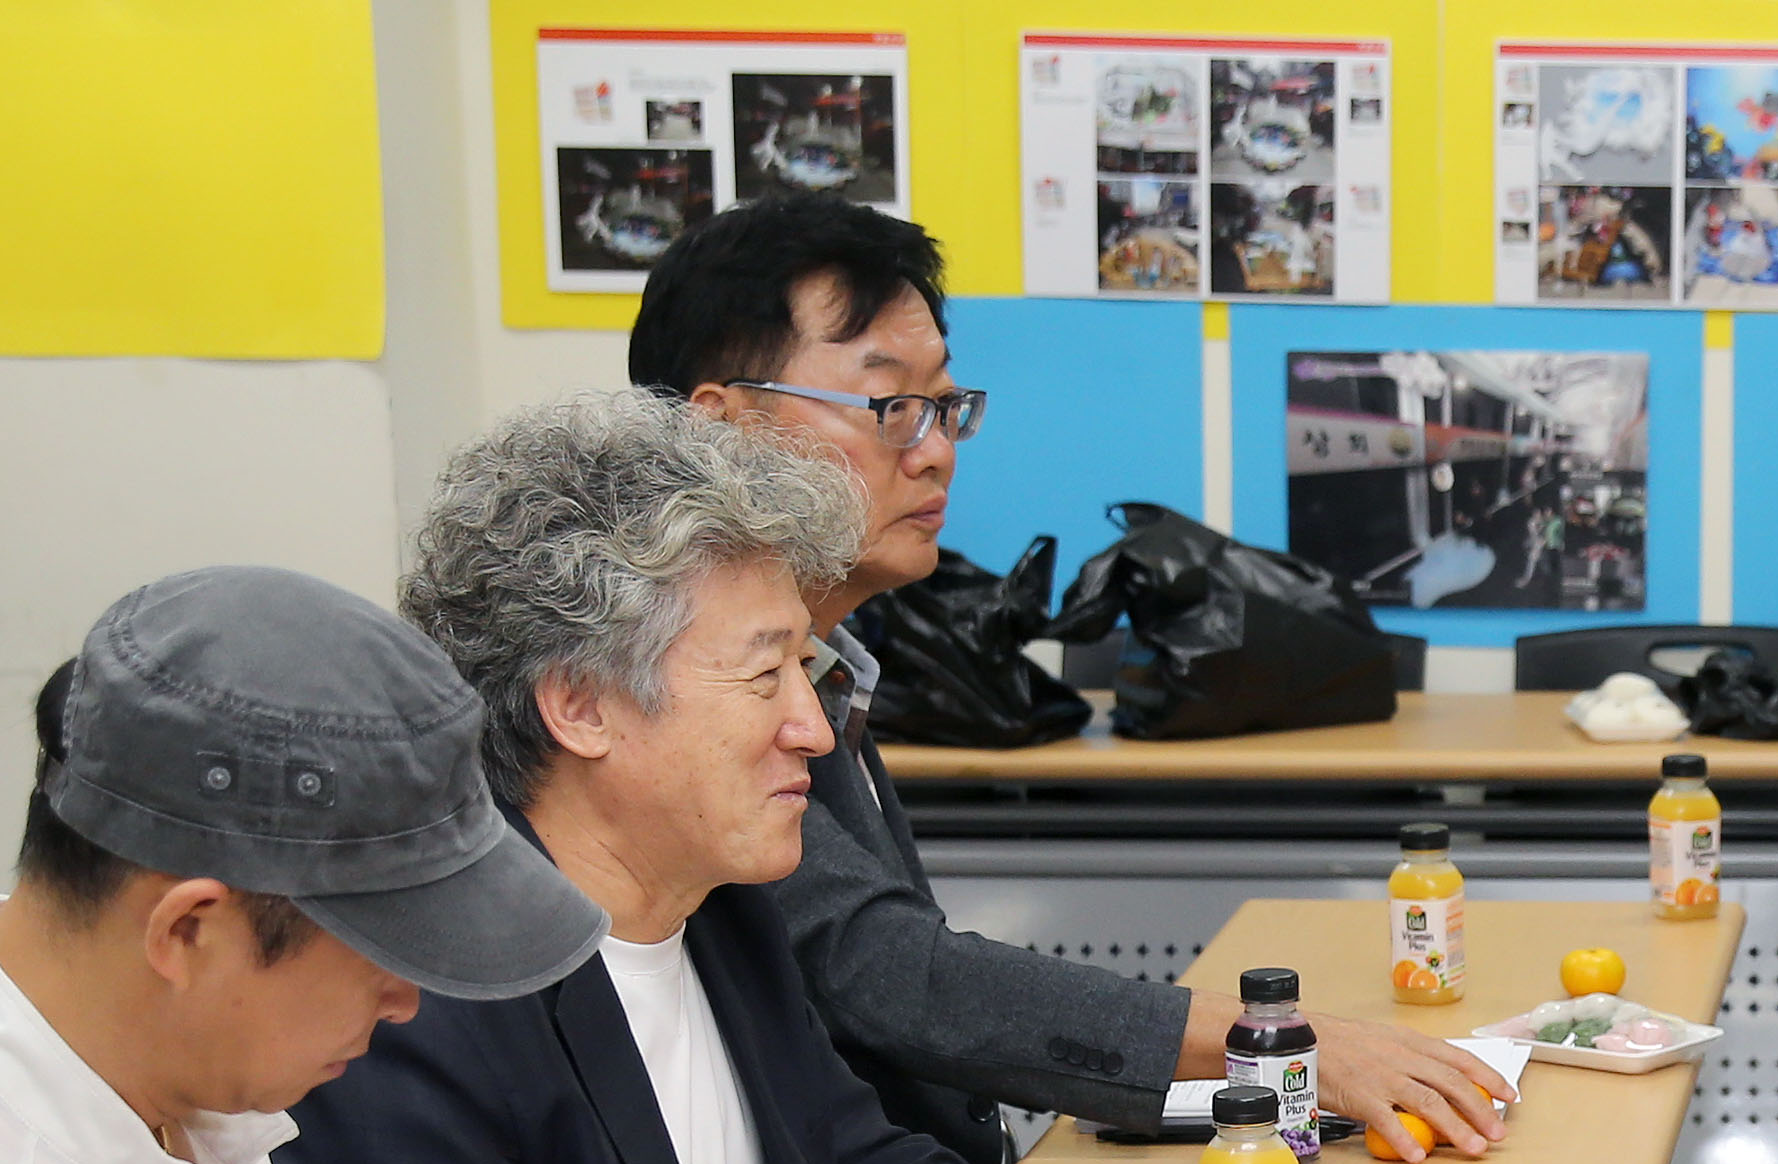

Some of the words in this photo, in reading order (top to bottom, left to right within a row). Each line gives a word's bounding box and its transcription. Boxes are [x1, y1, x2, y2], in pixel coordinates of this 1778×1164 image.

[1285, 1073, 1305, 1091] Cold
[1279, 1090, 1315, 1105] Vitamin
[1285, 1104, 1306, 1116] Plus
